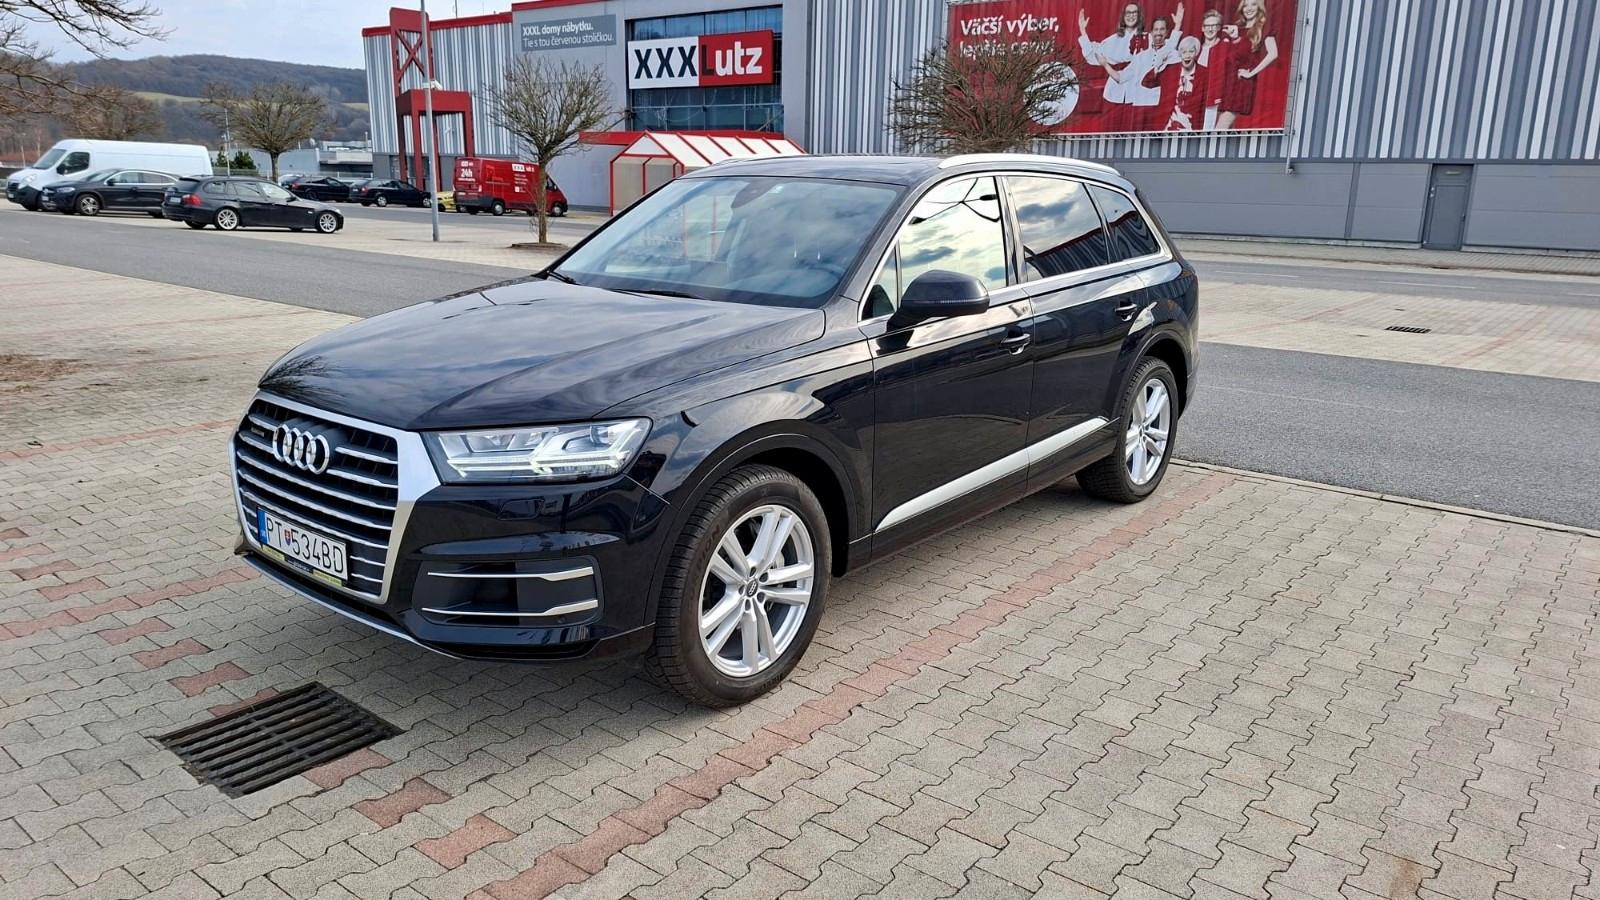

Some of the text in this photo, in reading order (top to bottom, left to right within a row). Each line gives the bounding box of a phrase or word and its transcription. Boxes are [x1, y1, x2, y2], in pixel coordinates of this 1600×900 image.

[522, 20, 594, 37] XXXL domy nábytku.
[960, 13, 1059, 36] Väčší výber,
[523, 38, 534, 48] Tie
[539, 38, 551, 47] tou
[551, 36, 581, 46] červenou
[582, 32, 614, 44] stoličkou.
[461, 168, 473, 178] 24h
[266, 517, 283, 548] PT
